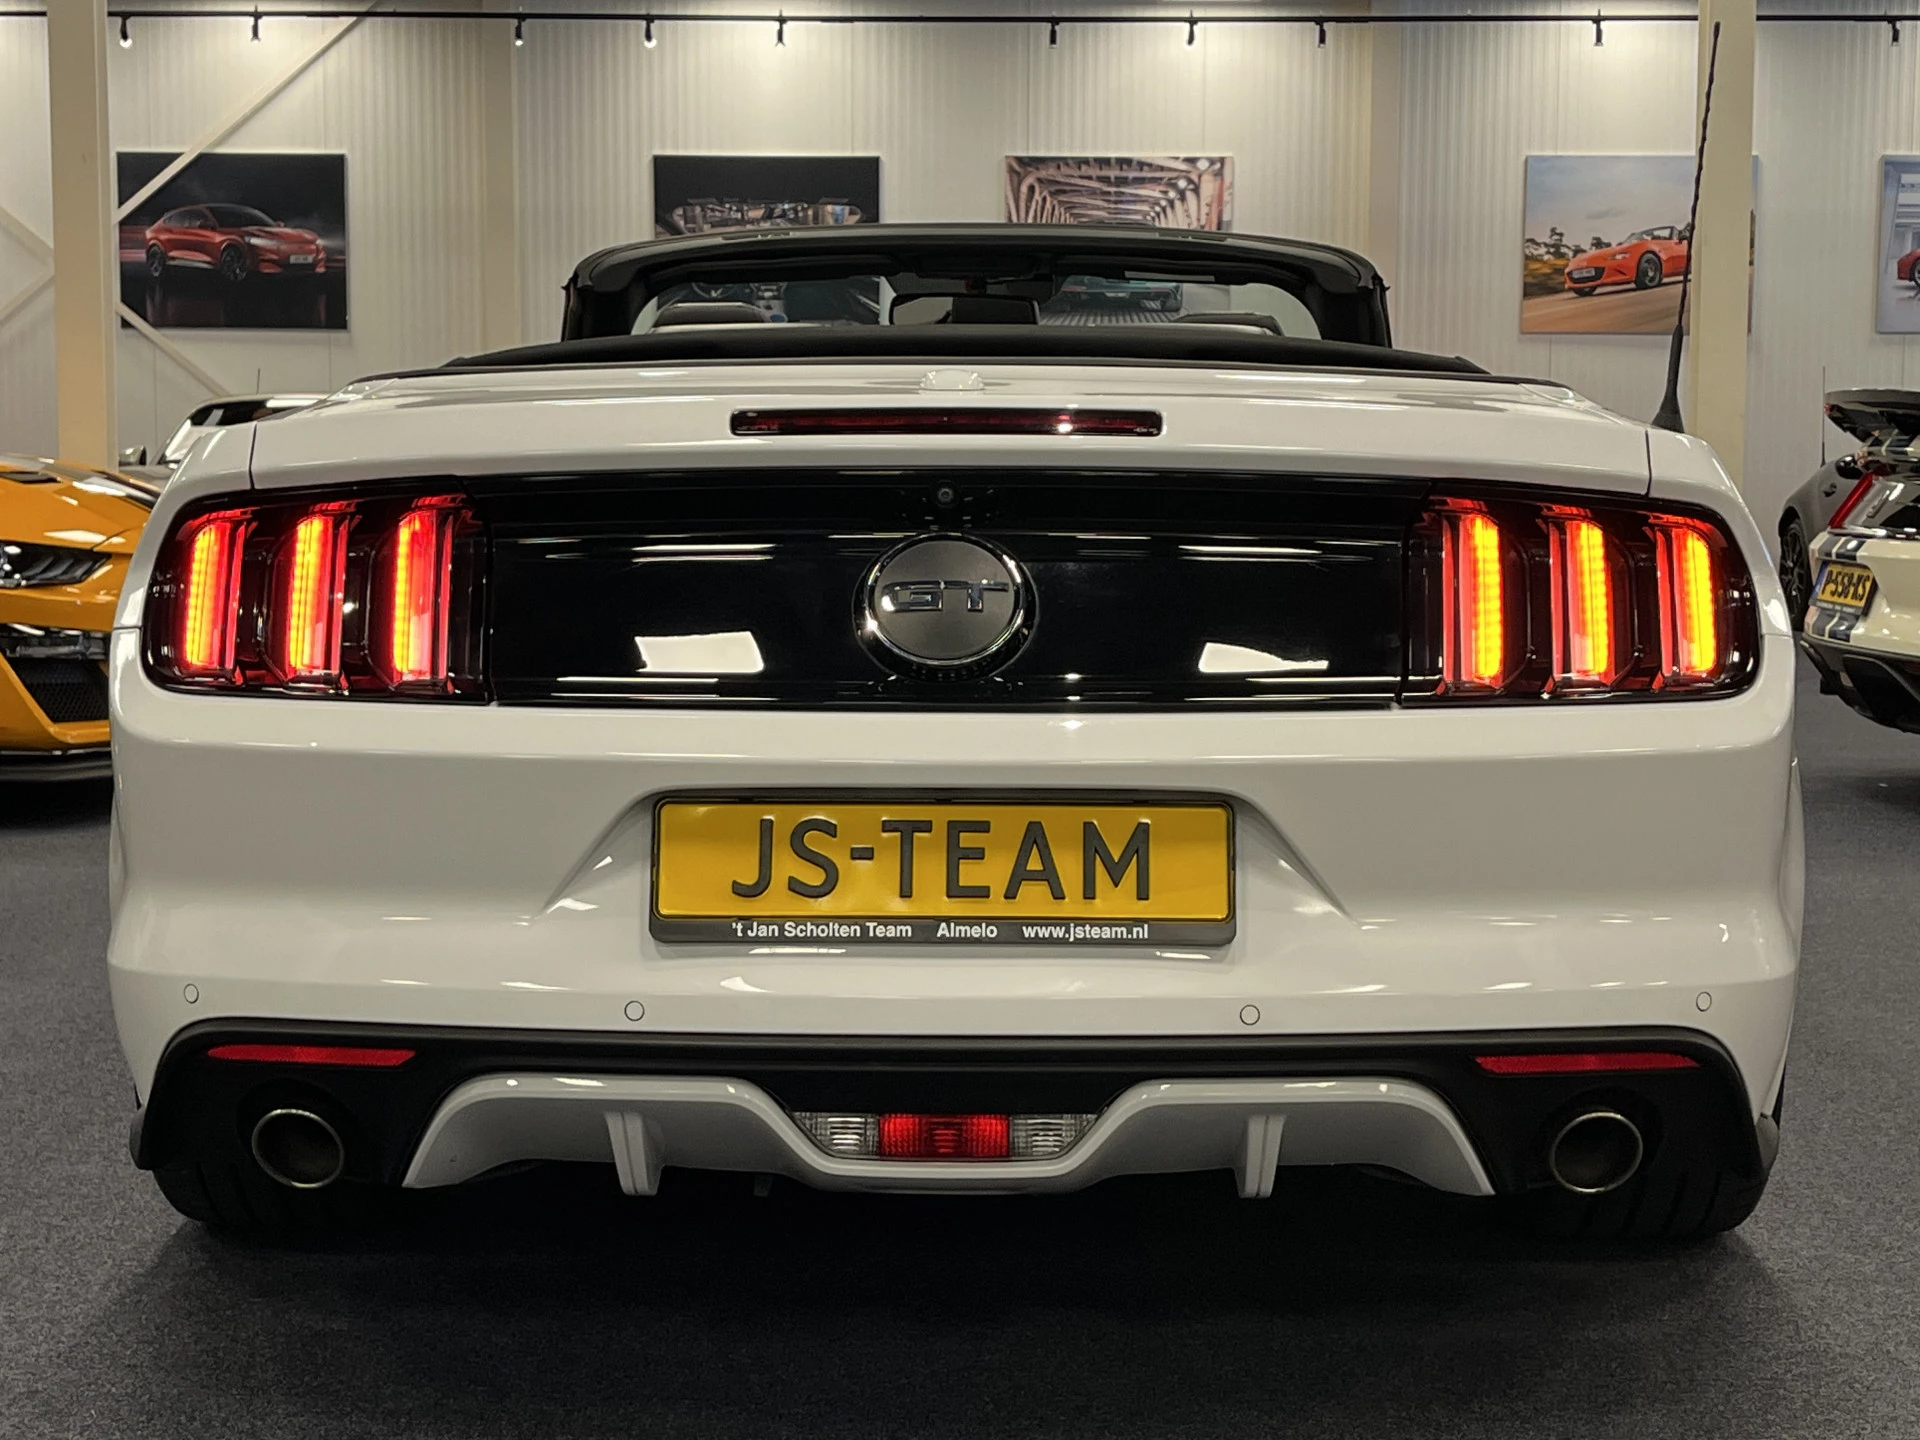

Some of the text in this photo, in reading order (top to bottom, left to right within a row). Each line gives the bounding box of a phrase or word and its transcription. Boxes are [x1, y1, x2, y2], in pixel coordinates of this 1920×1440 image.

[881, 579, 1009, 612] GT
[732, 818, 1150, 900] JS-TEAM
[748, 921, 778, 937] Jan
[784, 922, 860, 937] Scholten
[866, 922, 912, 937] Team
[936, 922, 998, 938] Almelo
[1022, 923, 1149, 941] www.jsteam.nl
